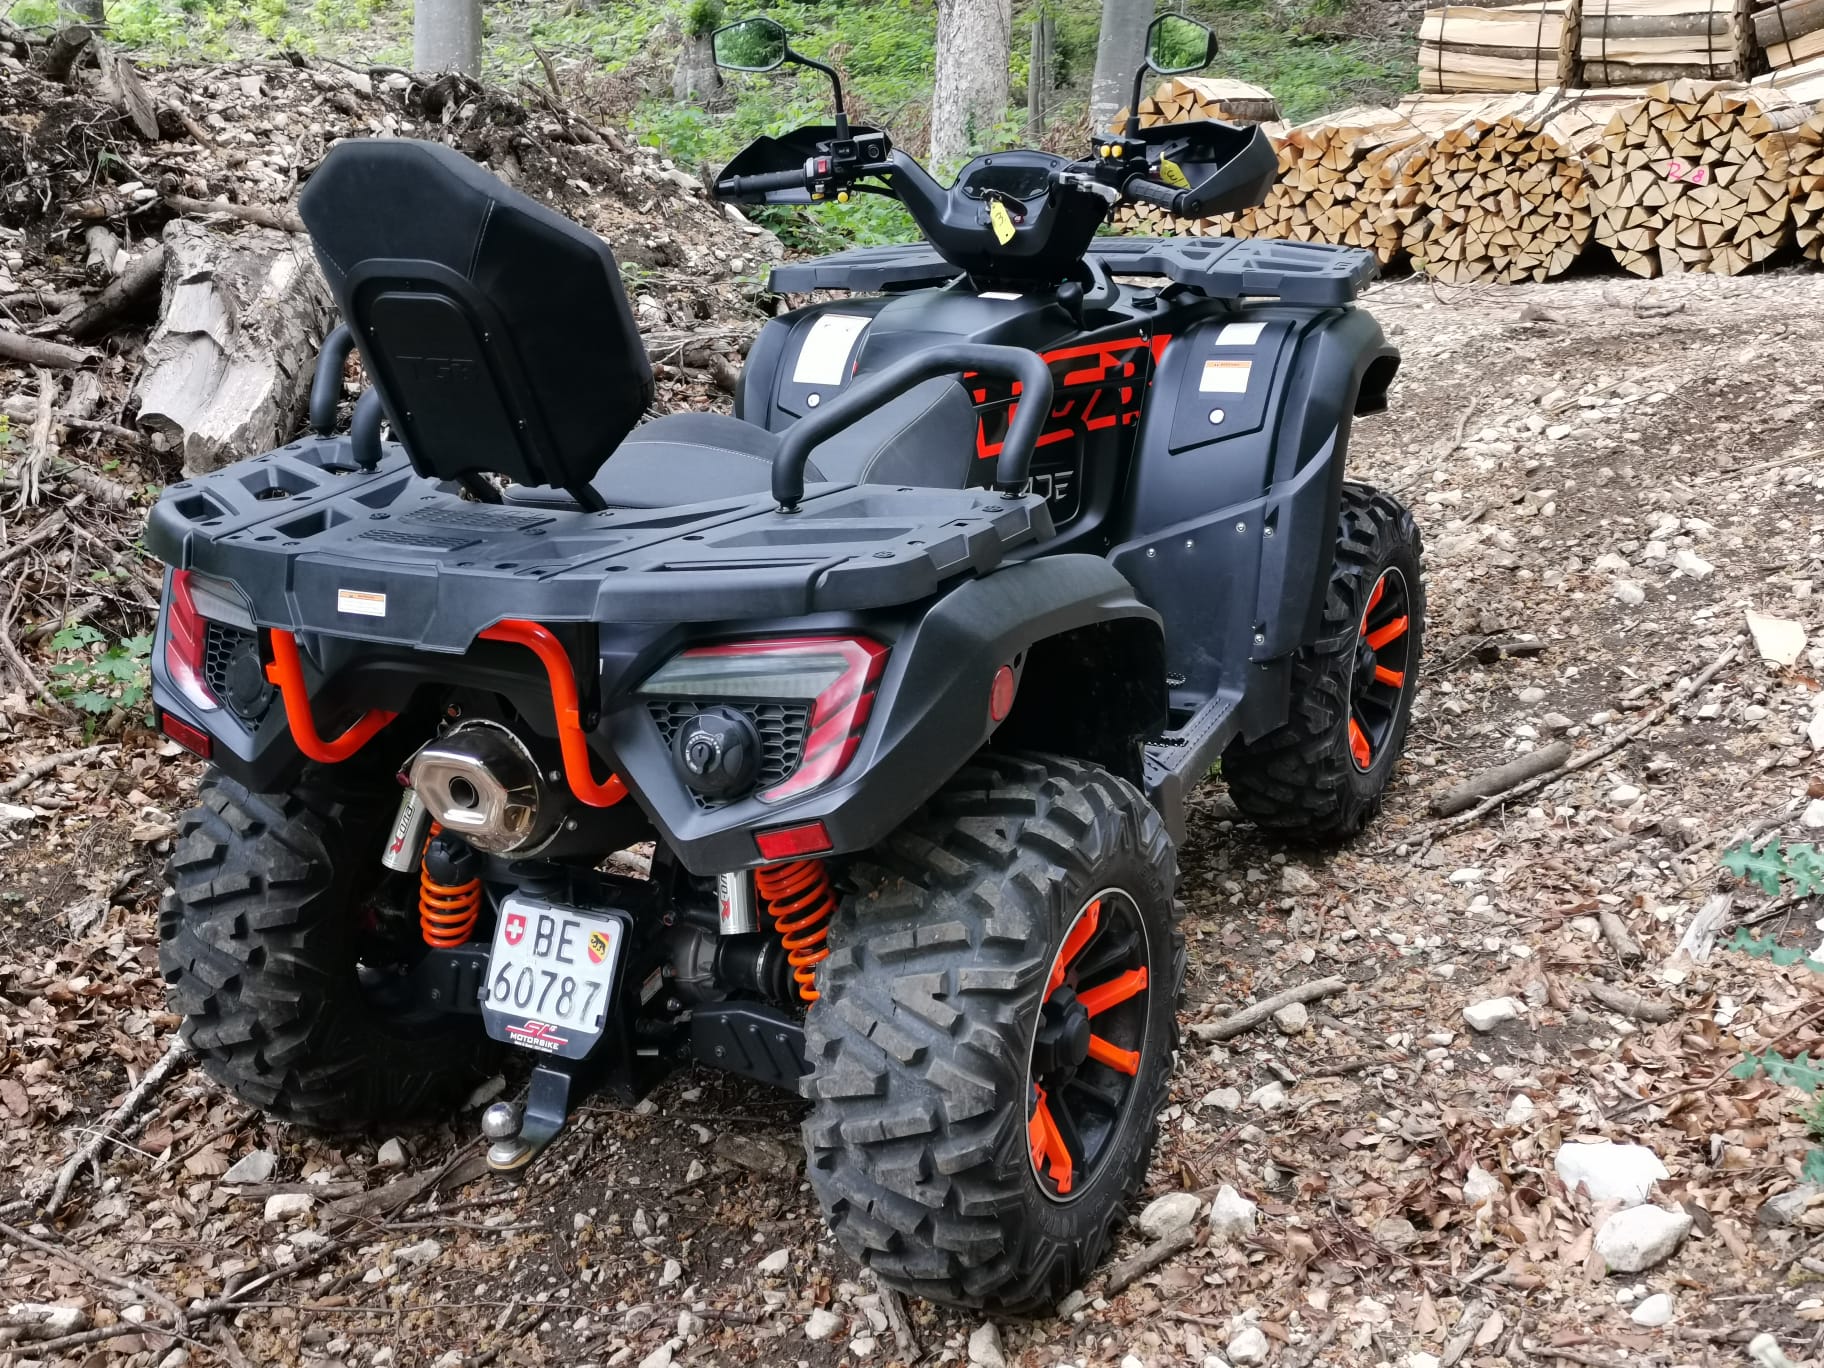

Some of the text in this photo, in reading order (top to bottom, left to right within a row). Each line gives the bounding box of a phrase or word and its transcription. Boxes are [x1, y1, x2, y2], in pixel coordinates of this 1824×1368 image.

[533, 914, 580, 965] BE
[493, 960, 602, 1024] 60787
[509, 1031, 560, 1050] MOTORBIKE
